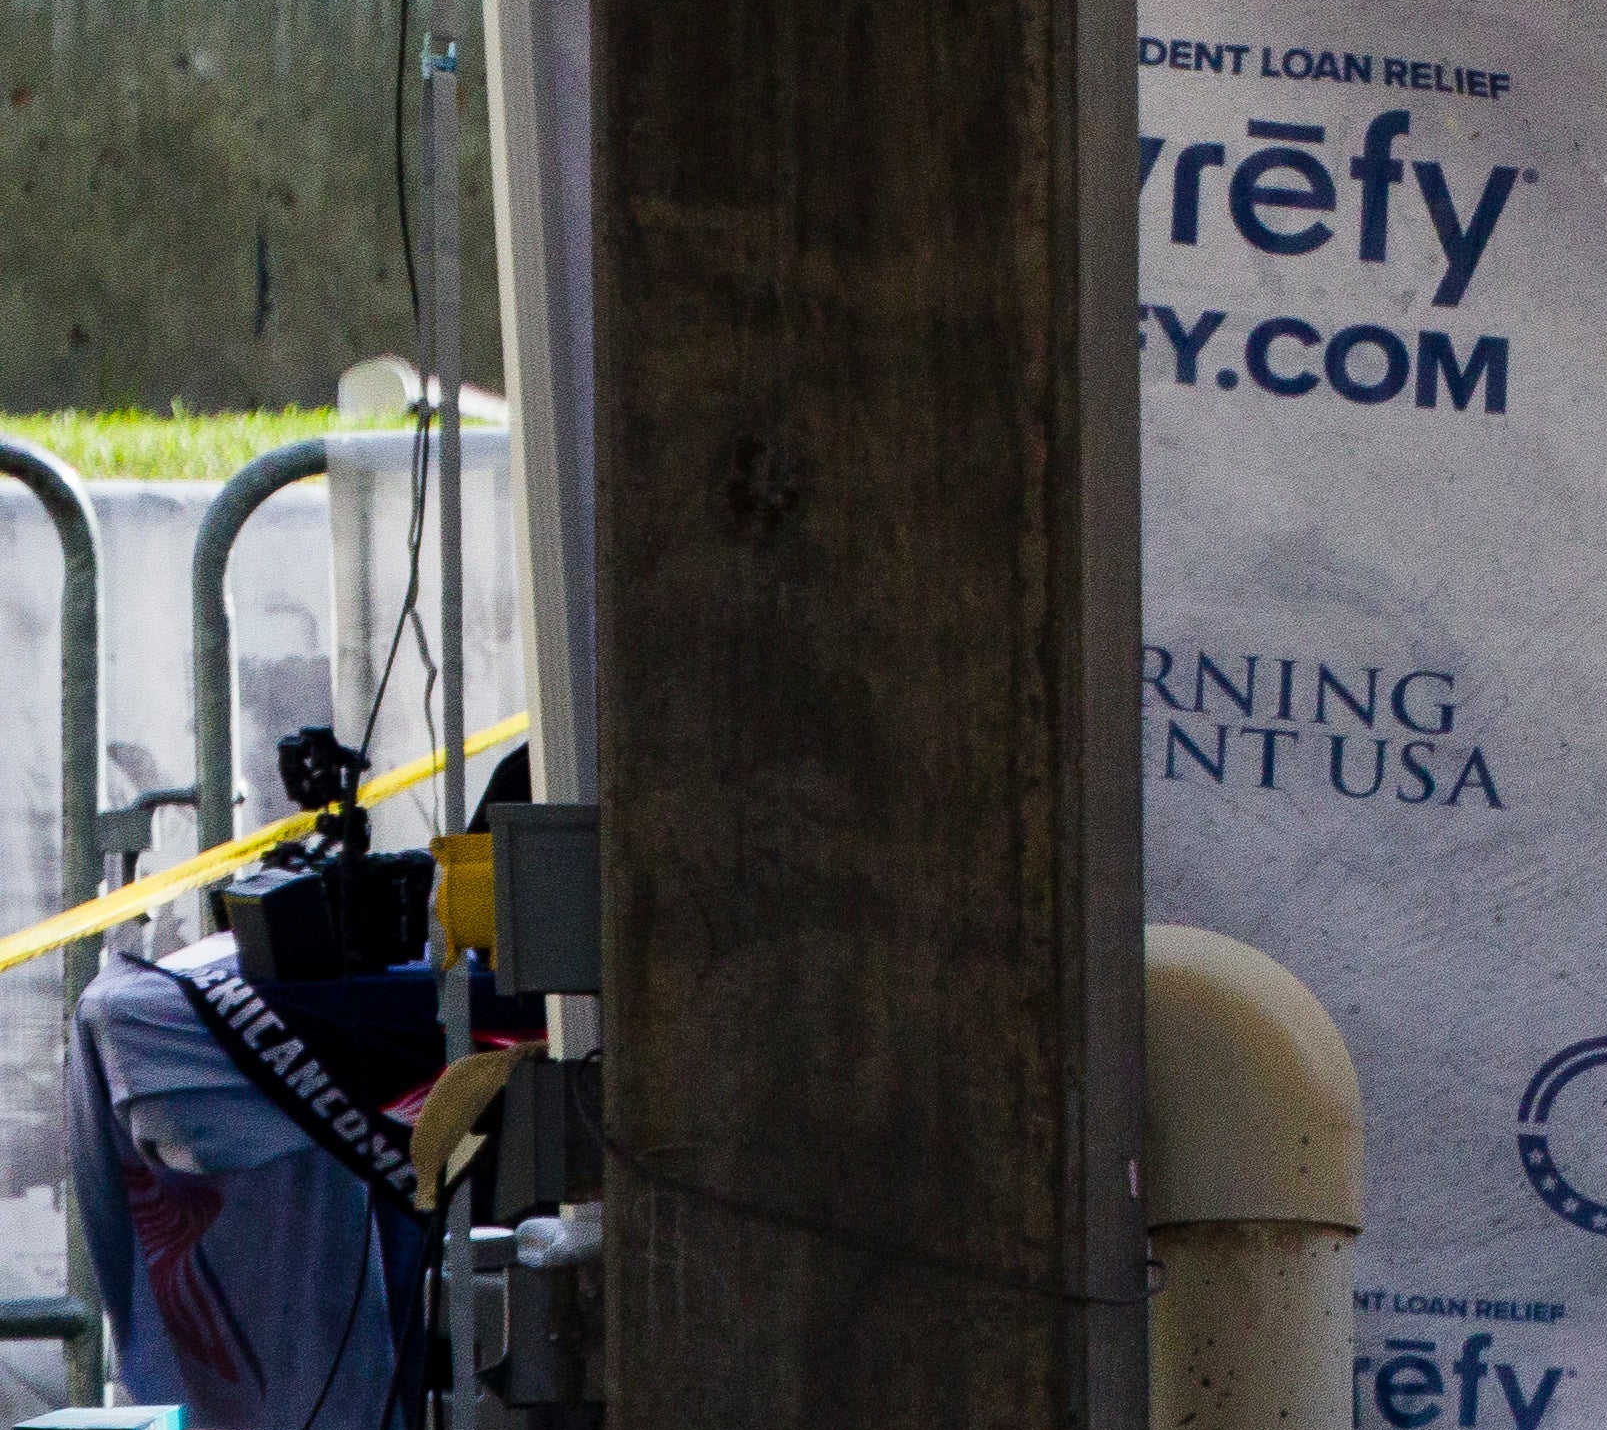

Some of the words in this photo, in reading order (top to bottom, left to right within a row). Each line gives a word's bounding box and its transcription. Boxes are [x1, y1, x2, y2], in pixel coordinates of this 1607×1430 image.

[1139, 36, 1250, 75] DENT
[1260, 46, 1371, 85] LOAN
[1383, 57, 1511, 101] RELIEF
[1139, 304, 1510, 415] Y.COM
[1142, 644, 1459, 735] RNING
[1325, 733, 1508, 810] USA
[1394, 1293, 1468, 1317] LOAN
[1475, 1299, 1566, 1323] RELIEF
